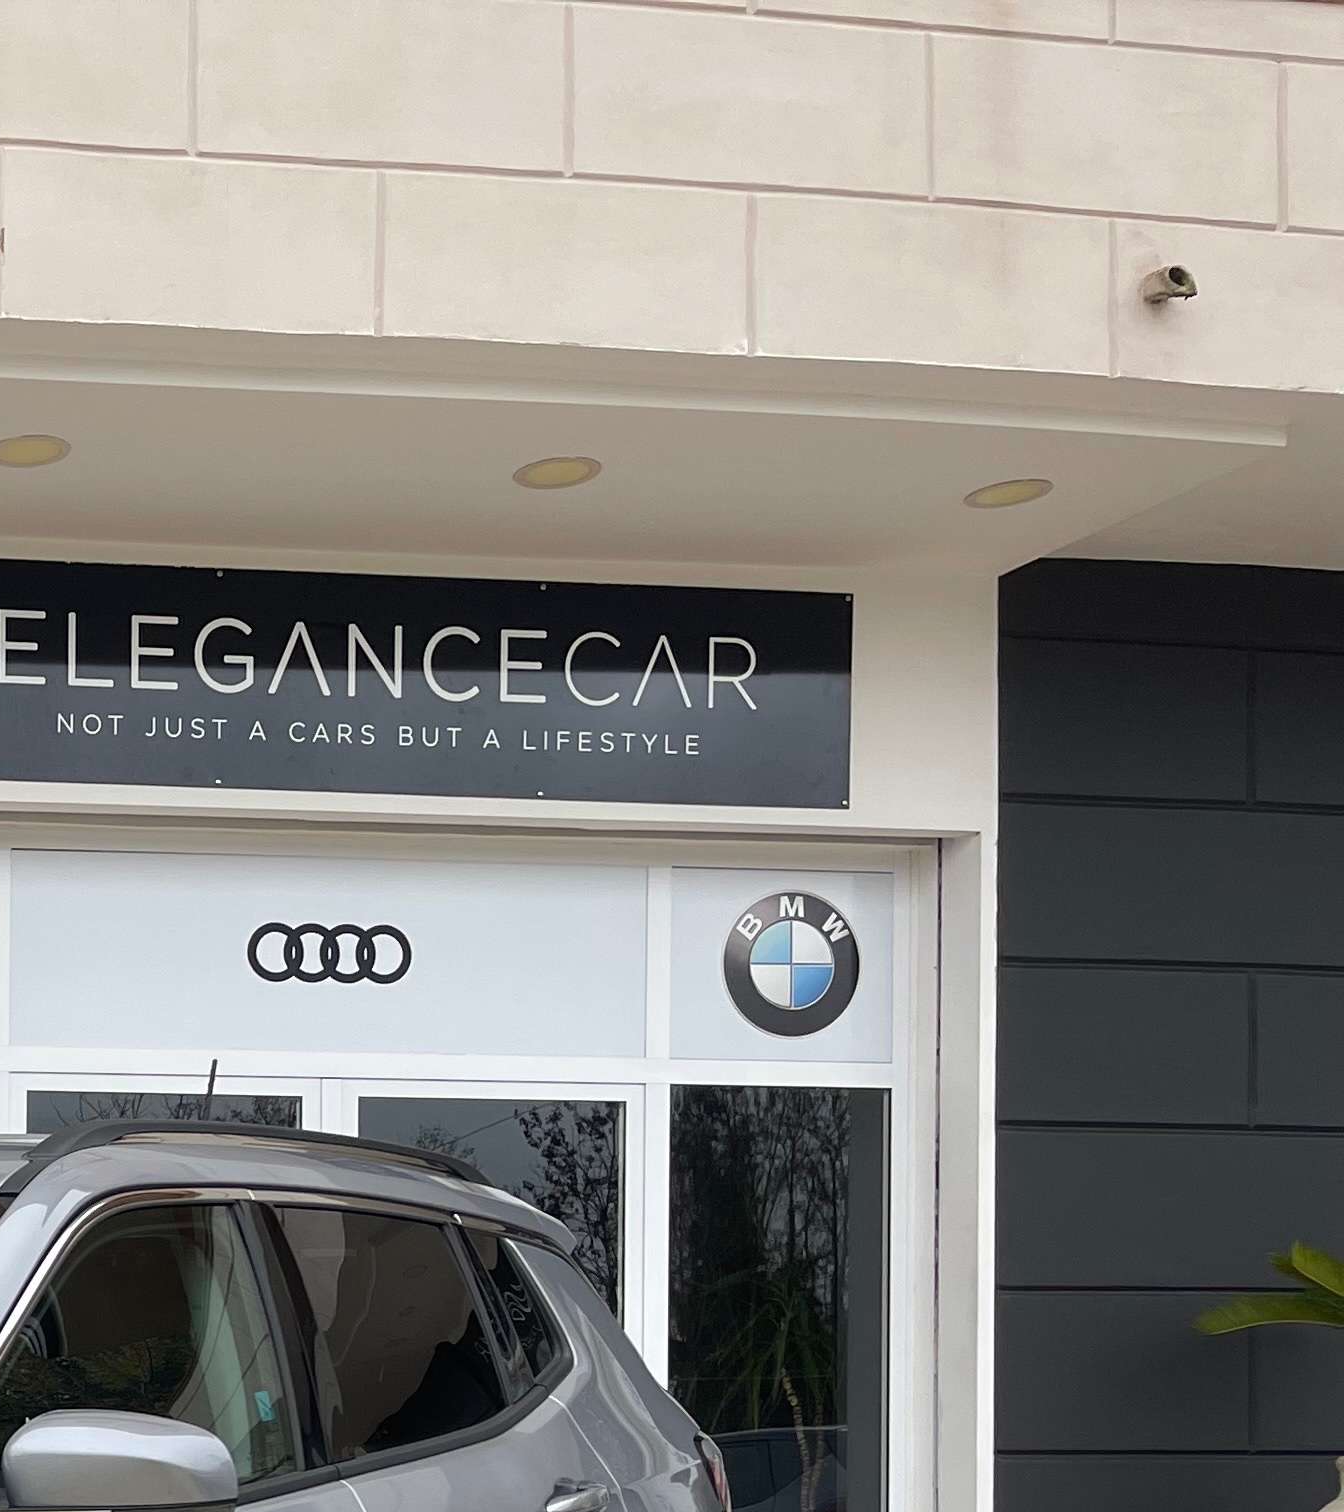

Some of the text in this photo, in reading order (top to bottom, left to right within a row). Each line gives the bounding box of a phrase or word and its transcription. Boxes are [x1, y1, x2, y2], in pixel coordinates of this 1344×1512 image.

[57, 712, 700, 755] NOT JUST A CARS BUT A LIFESTYLE
